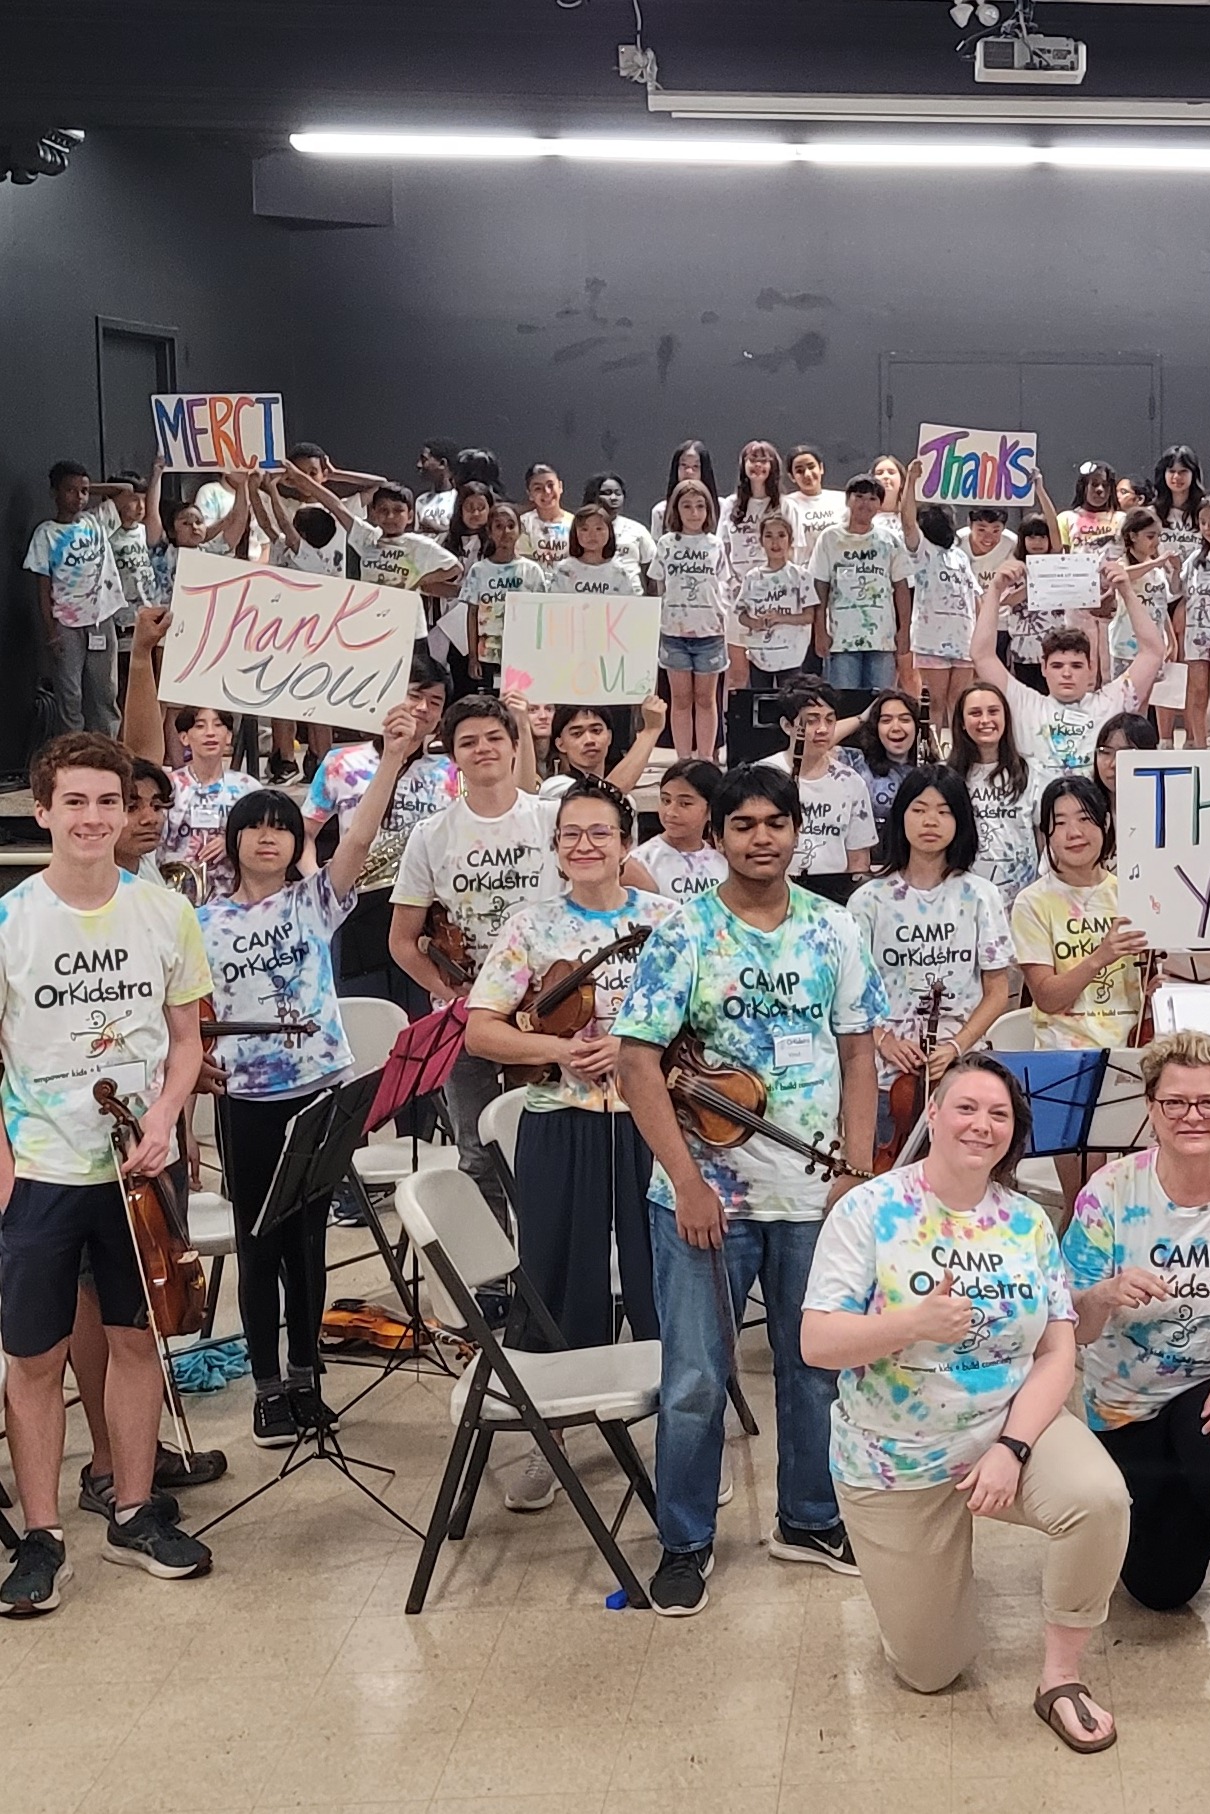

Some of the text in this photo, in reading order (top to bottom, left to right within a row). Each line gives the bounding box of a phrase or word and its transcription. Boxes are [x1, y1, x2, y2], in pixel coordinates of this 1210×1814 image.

[155, 397, 284, 468] MERCI
[673, 550, 709, 561] CAMP
[488, 577, 523, 589] CAMP
[575, 581, 609, 594] CAMP
[801, 802, 831, 817] AMP
[467, 848, 524, 868] CAMP
[452, 871, 539, 893] OrKidstra
[895, 922, 955, 942] CAMP
[1066, 917, 1117, 935] CAM
[232, 921, 293, 954] CAMP
[54, 948, 128, 976] CAMP
[883, 946, 972, 967] OrKidstra
[739, 967, 800, 995] CAMP
[35, 978, 153, 1009] OrKidstra
[34, 1068, 87, 1084] empower kids
[931, 1245, 1004, 1272] CAMP
[909, 1271, 1034, 1300] OKidstra
